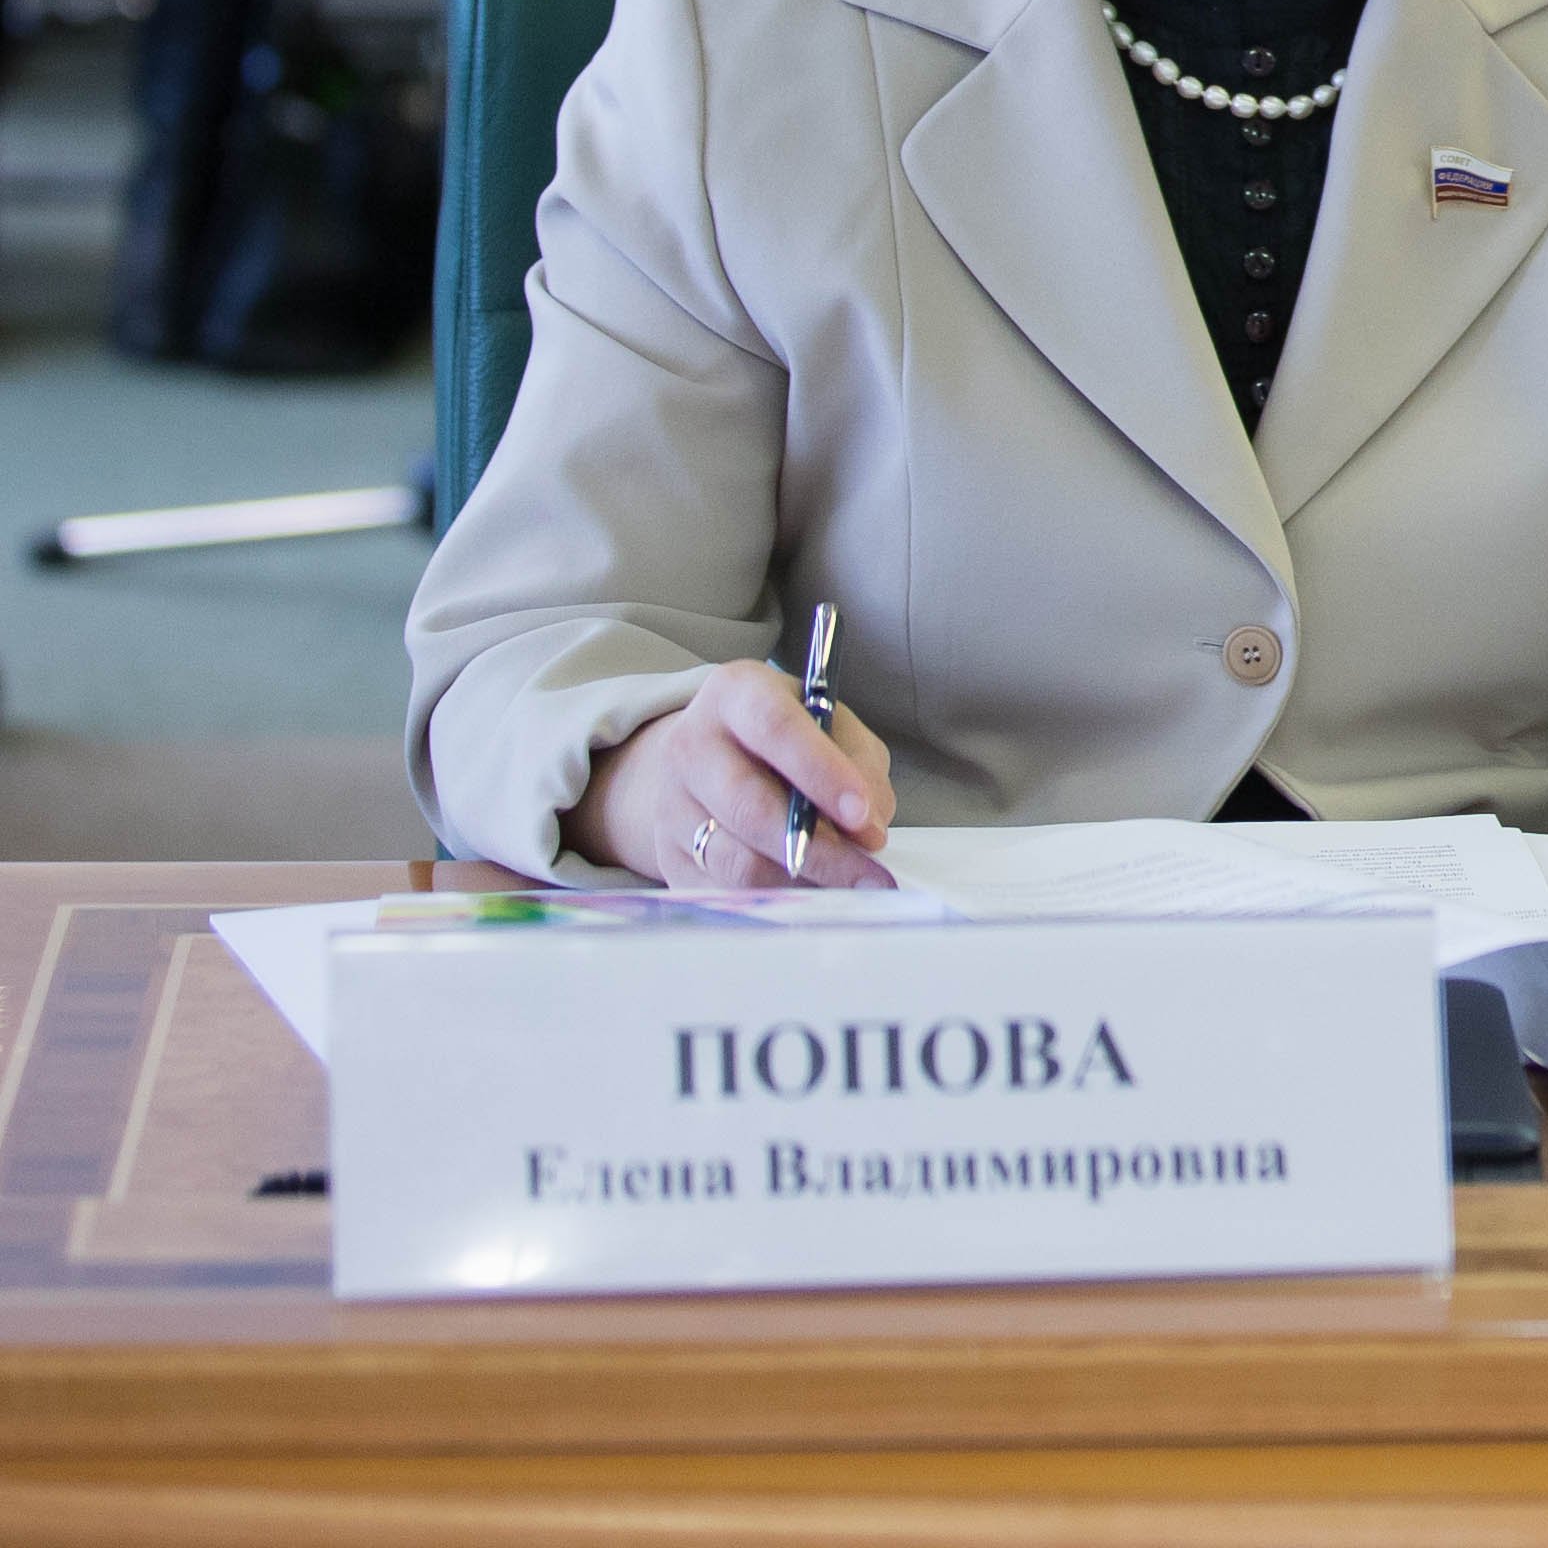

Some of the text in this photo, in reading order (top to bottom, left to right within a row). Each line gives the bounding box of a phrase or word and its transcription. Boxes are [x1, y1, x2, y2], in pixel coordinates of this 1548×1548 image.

[1441, 155, 1471, 167] СОВЕТ
[673, 1017, 1135, 1100] ПОПОВА
[524, 1139, 1289, 1204] Елена Владимировна
